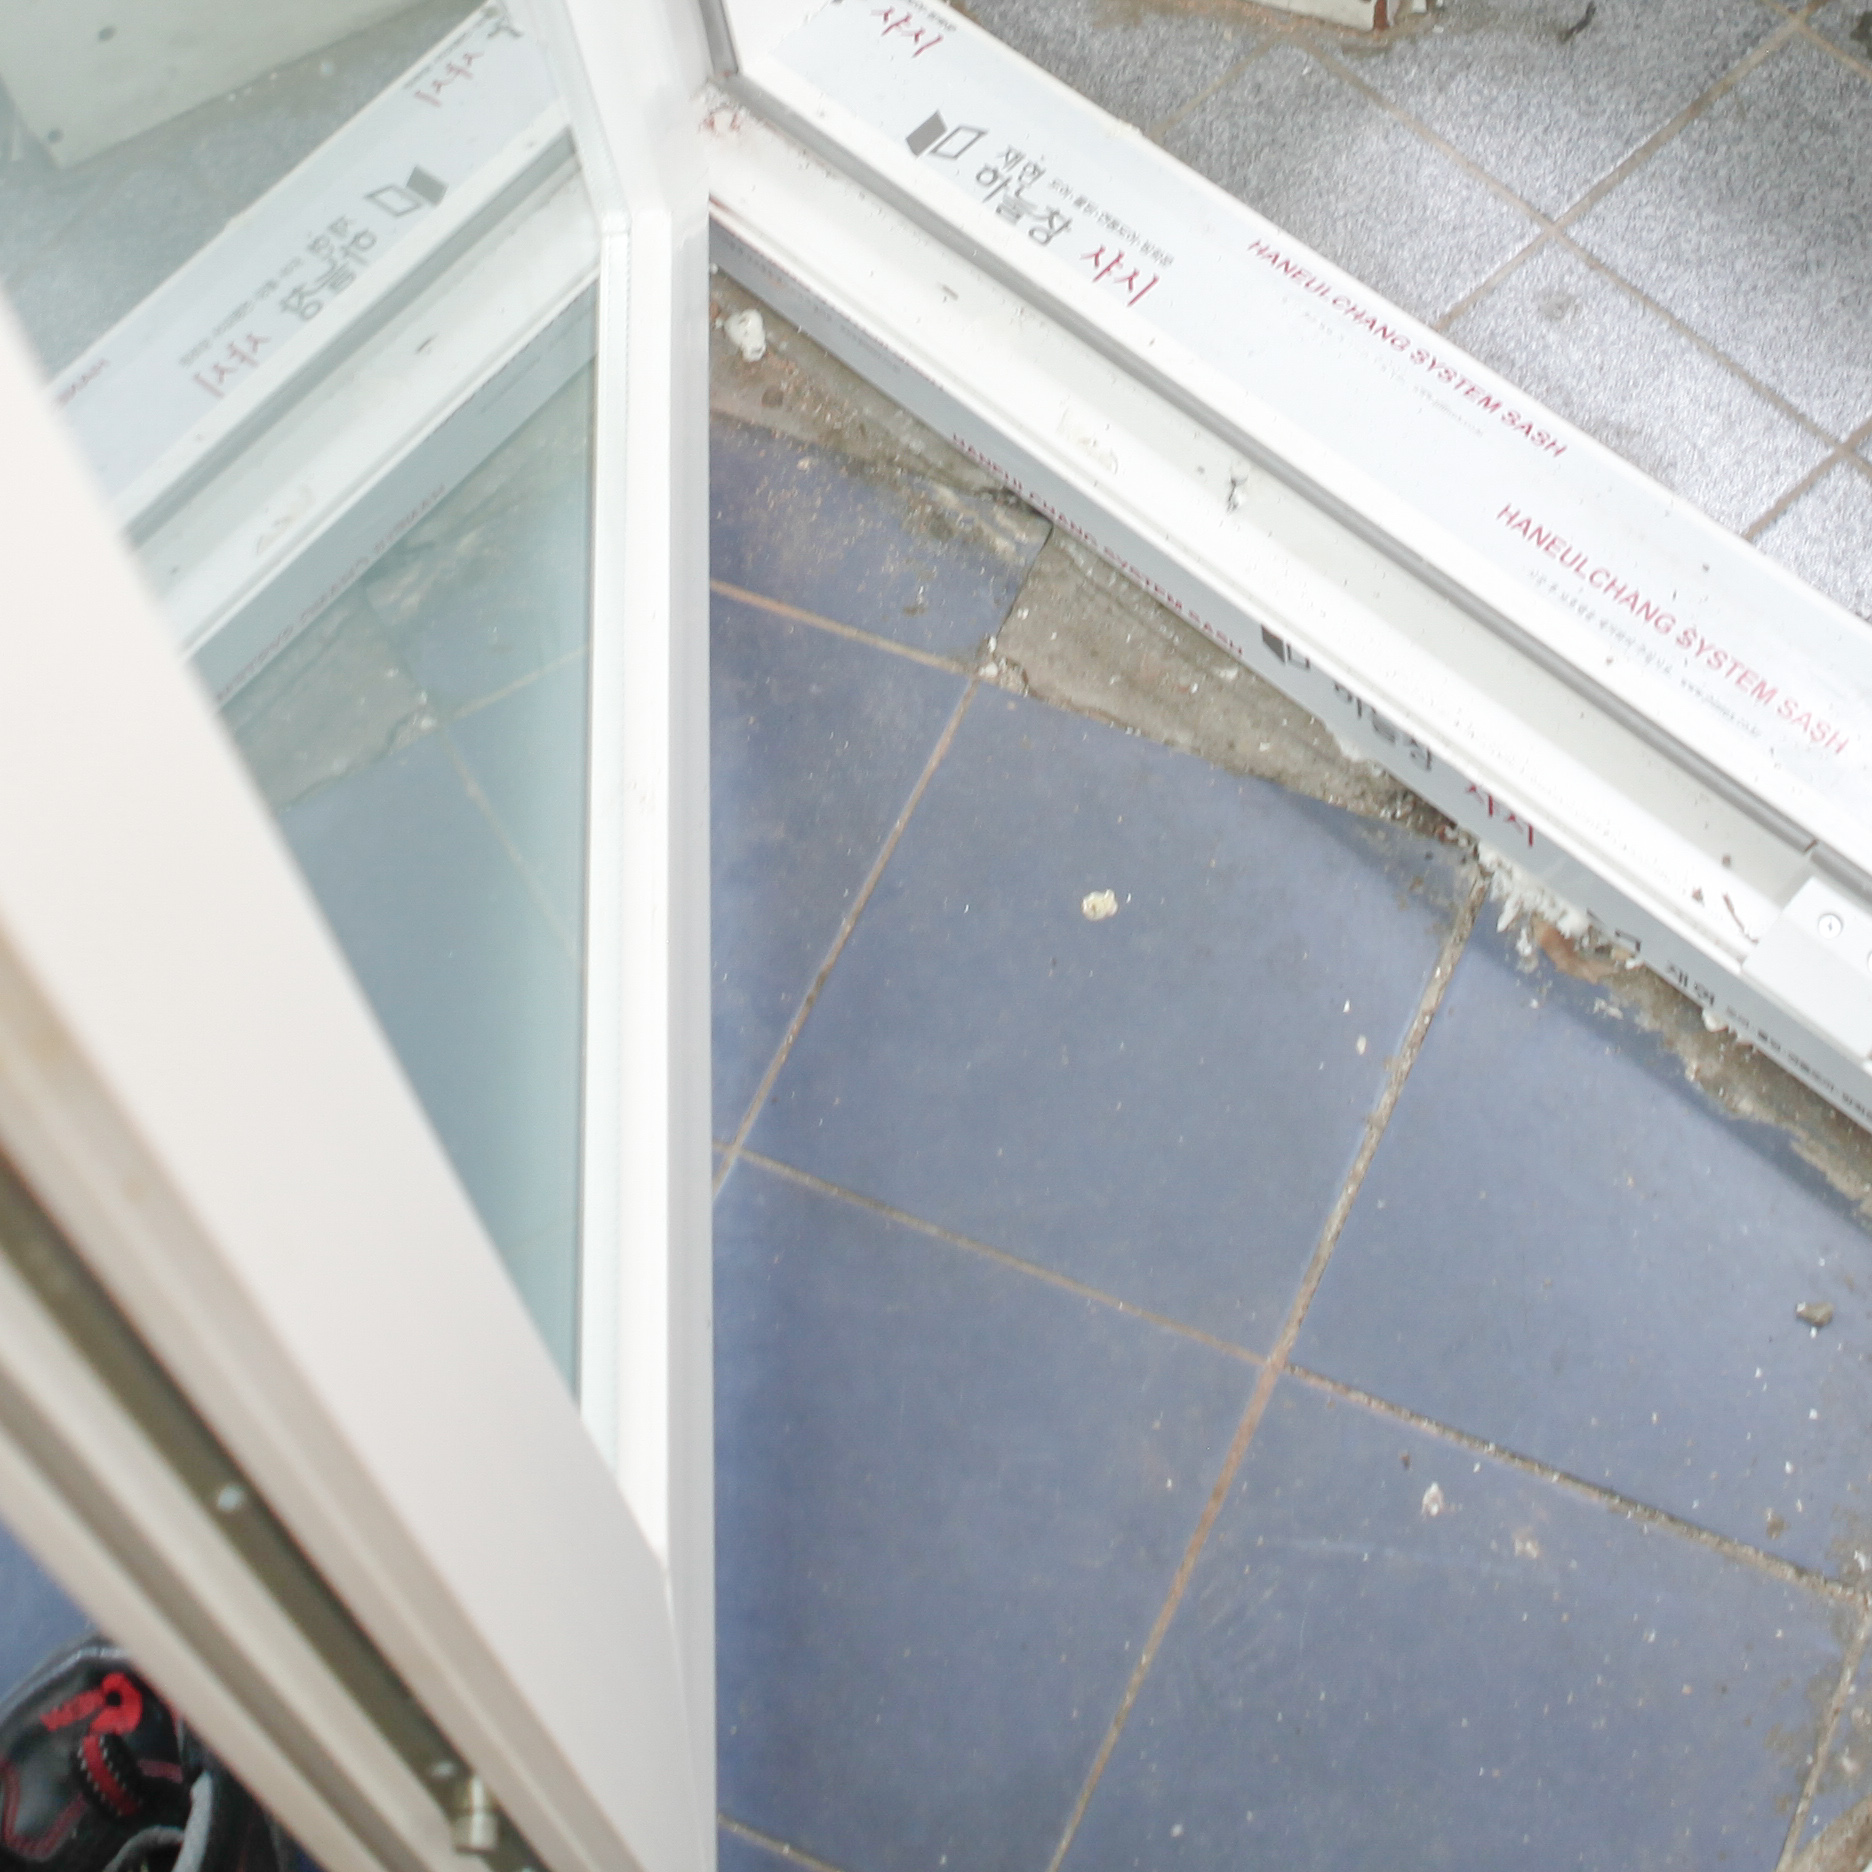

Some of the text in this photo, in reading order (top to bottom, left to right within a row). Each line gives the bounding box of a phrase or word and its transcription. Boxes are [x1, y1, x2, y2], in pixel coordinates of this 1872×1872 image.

[1408, 346, 1504, 415] SYSTEM
[1497, 407, 1568, 460] SASH
[1674, 625, 1780, 708] SYSTEM
[1776, 697, 1850, 758] SASH
